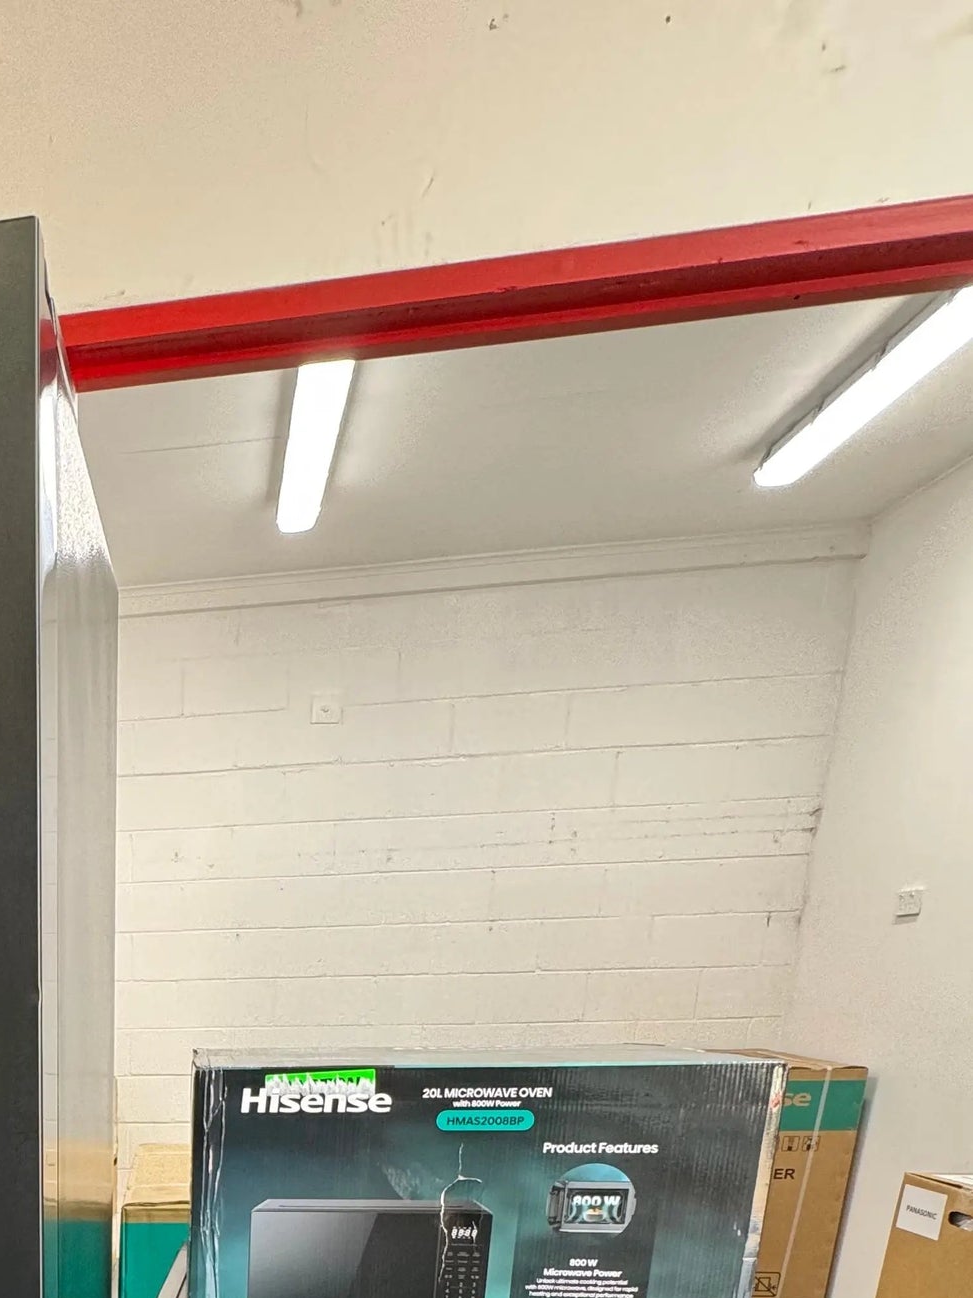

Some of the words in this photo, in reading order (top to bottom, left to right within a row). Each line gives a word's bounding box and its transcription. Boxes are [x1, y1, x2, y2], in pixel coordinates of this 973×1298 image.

[422, 1088, 443, 1098] 20L
[444, 1087, 518, 1098] MICROWAVE
[519, 1087, 553, 1098] OVEN
[241, 1087, 392, 1113] Hisense
[447, 1116, 524, 1126] HMAS2008BP
[542, 1142, 597, 1154] Product
[598, 1142, 659, 1154] Features
[603, 1195, 621, 1206] W
[905, 1204, 937, 1220] PANASONIC
[569, 1259, 587, 1267] 800
[587, 1259, 598, 1267] W
[543, 1268, 593, 1277] Microwave
[593, 1269, 623, 1278] Power
